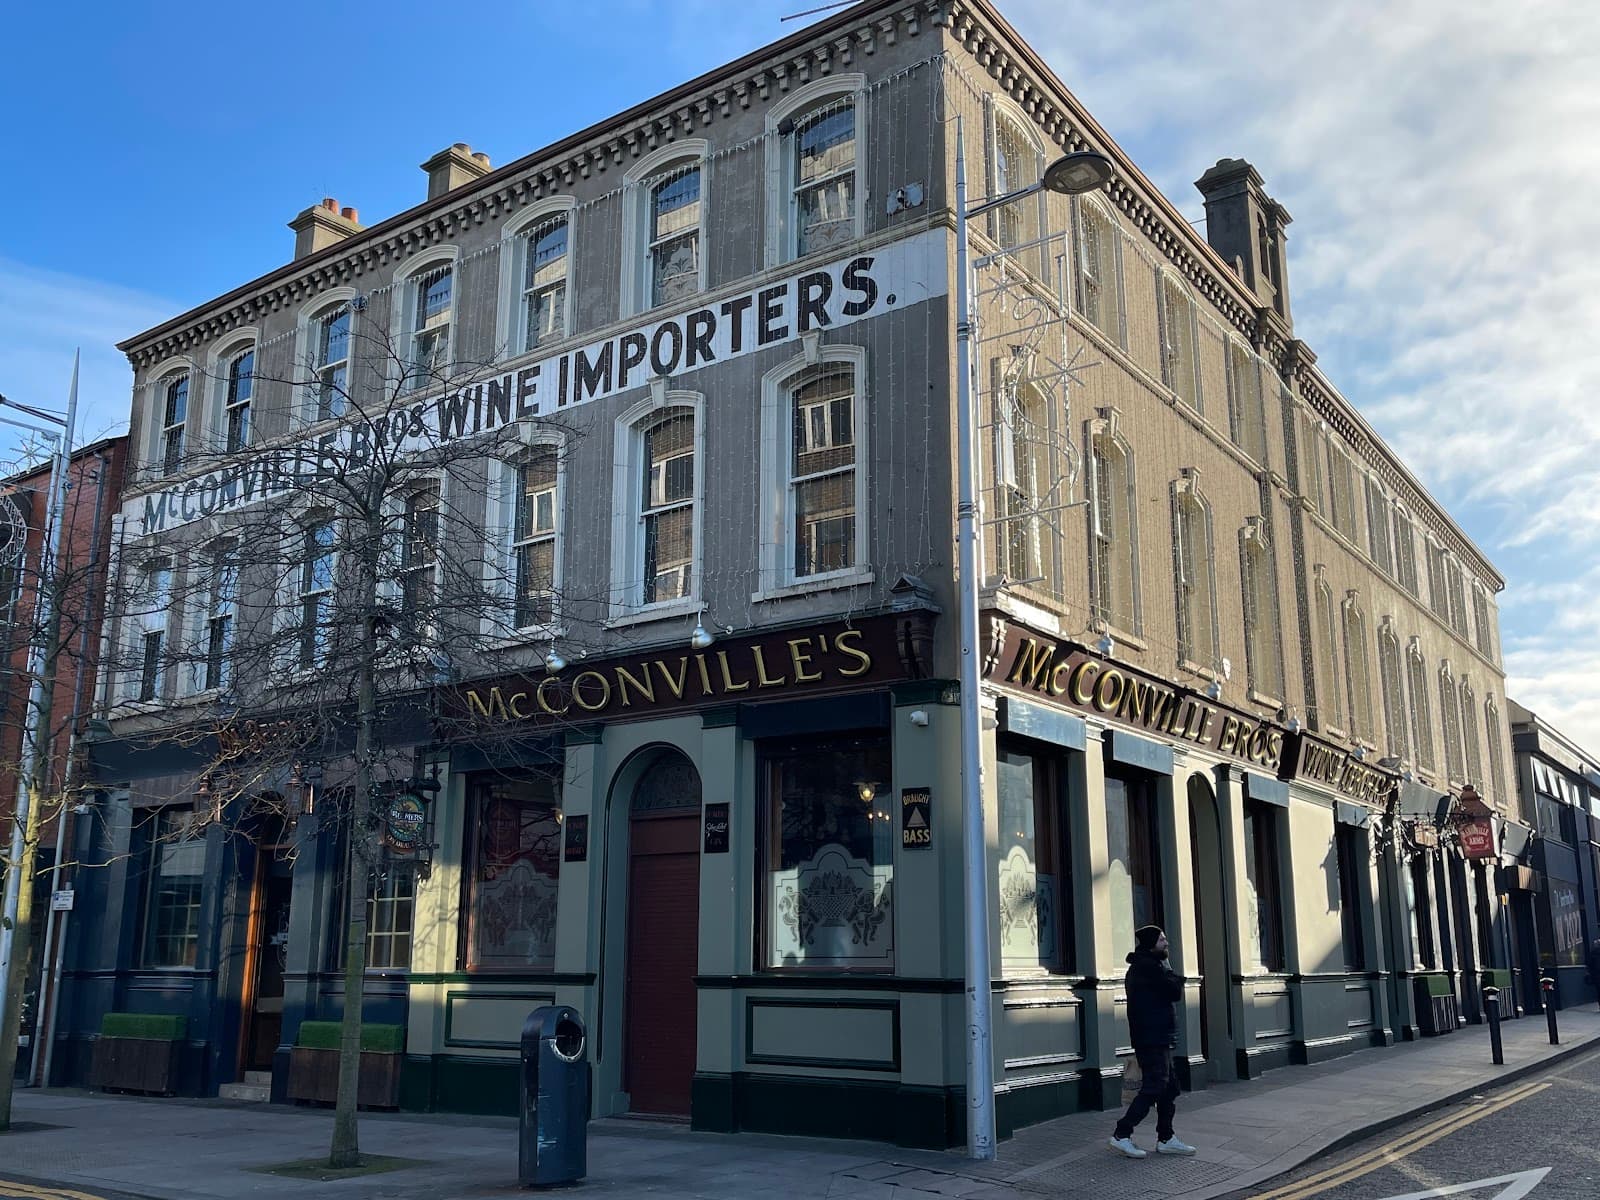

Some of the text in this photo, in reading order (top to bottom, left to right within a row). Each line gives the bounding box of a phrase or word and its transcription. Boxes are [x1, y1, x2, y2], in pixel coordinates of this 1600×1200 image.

[437, 365, 542, 442] WINE
[557, 256, 898, 407] IMPORTERS.
[902, 793, 929, 806] DRAUGHT
[391, 810, 424, 822] BUMERS
[903, 829, 930, 844] BASS
